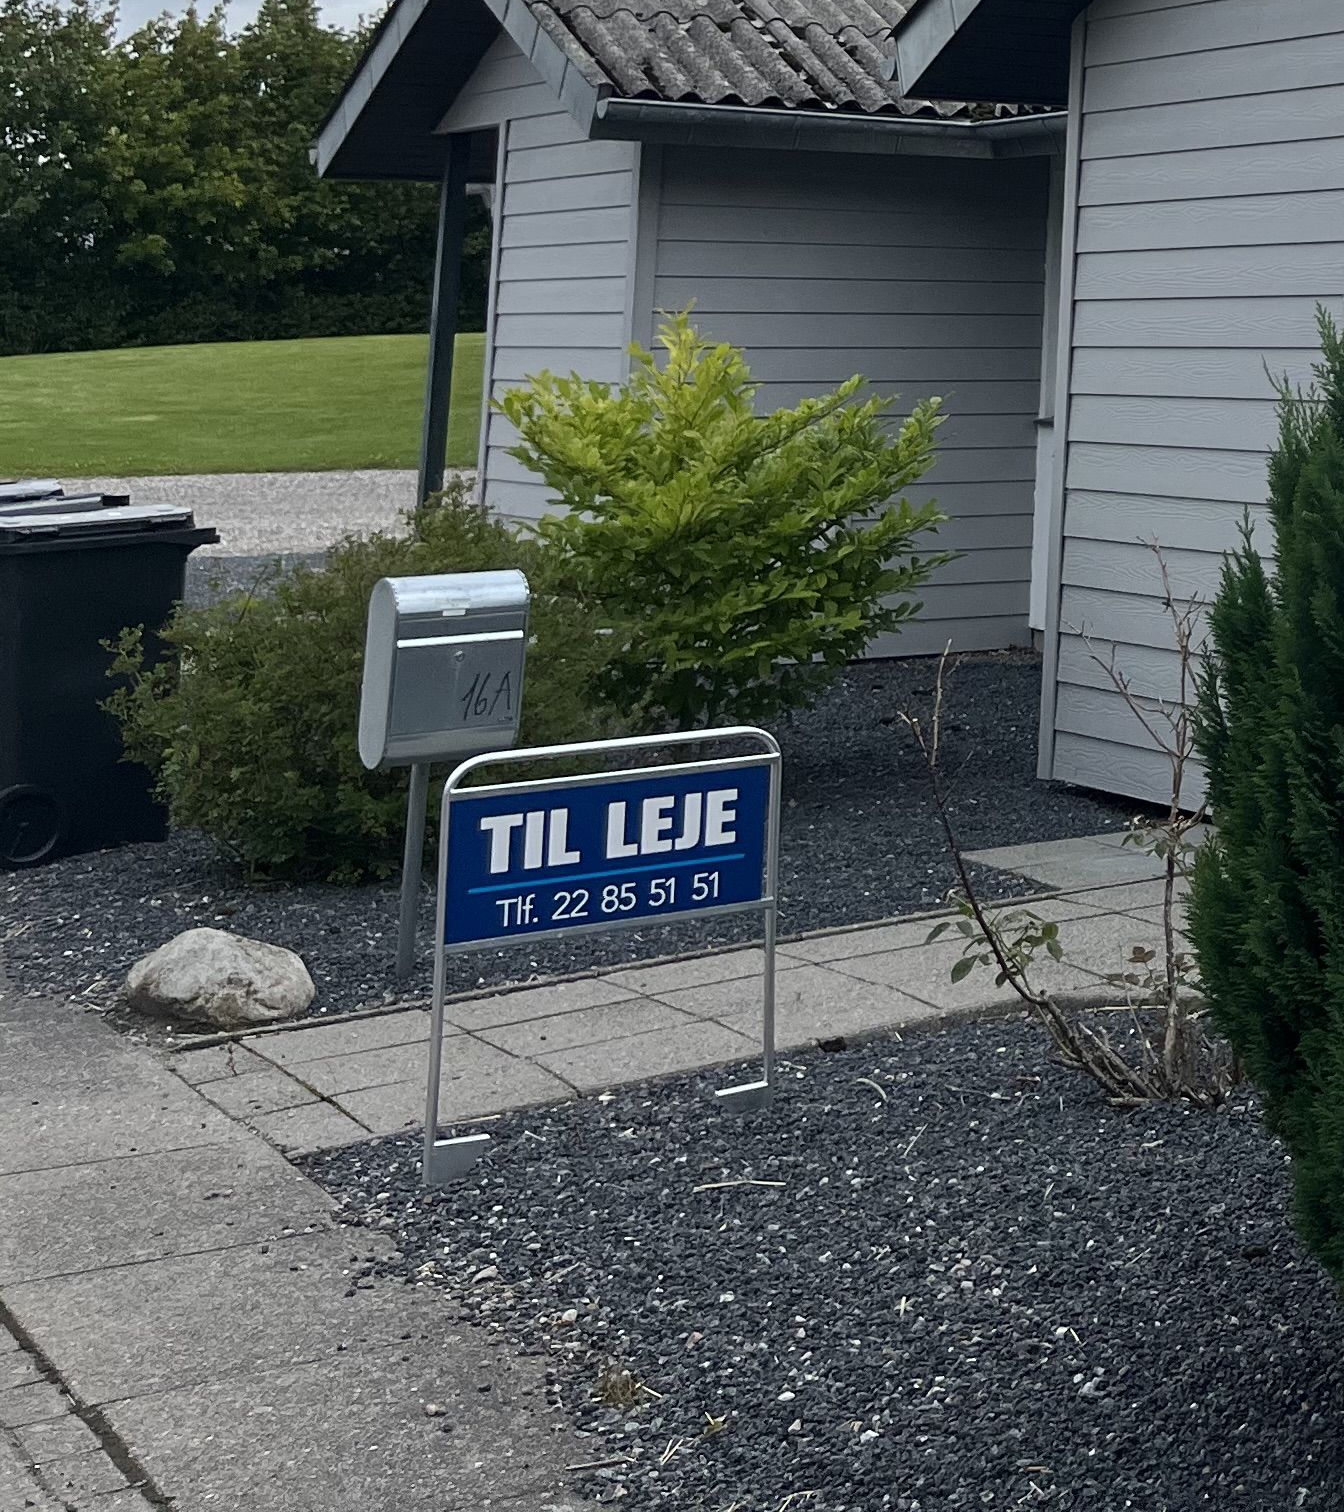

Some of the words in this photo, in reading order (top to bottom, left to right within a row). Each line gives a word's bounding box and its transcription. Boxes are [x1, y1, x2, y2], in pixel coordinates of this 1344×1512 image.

[462, 671, 511, 720] 16A
[480, 807, 580, 875] TIL
[606, 788, 738, 859] LEJE
[495, 894, 538, 927] Tlf.
[551, 889, 589, 921] 22
[600, 882, 637, 913] 85
[648, 876, 676, 908] 51
[691, 871, 719, 900] 51
